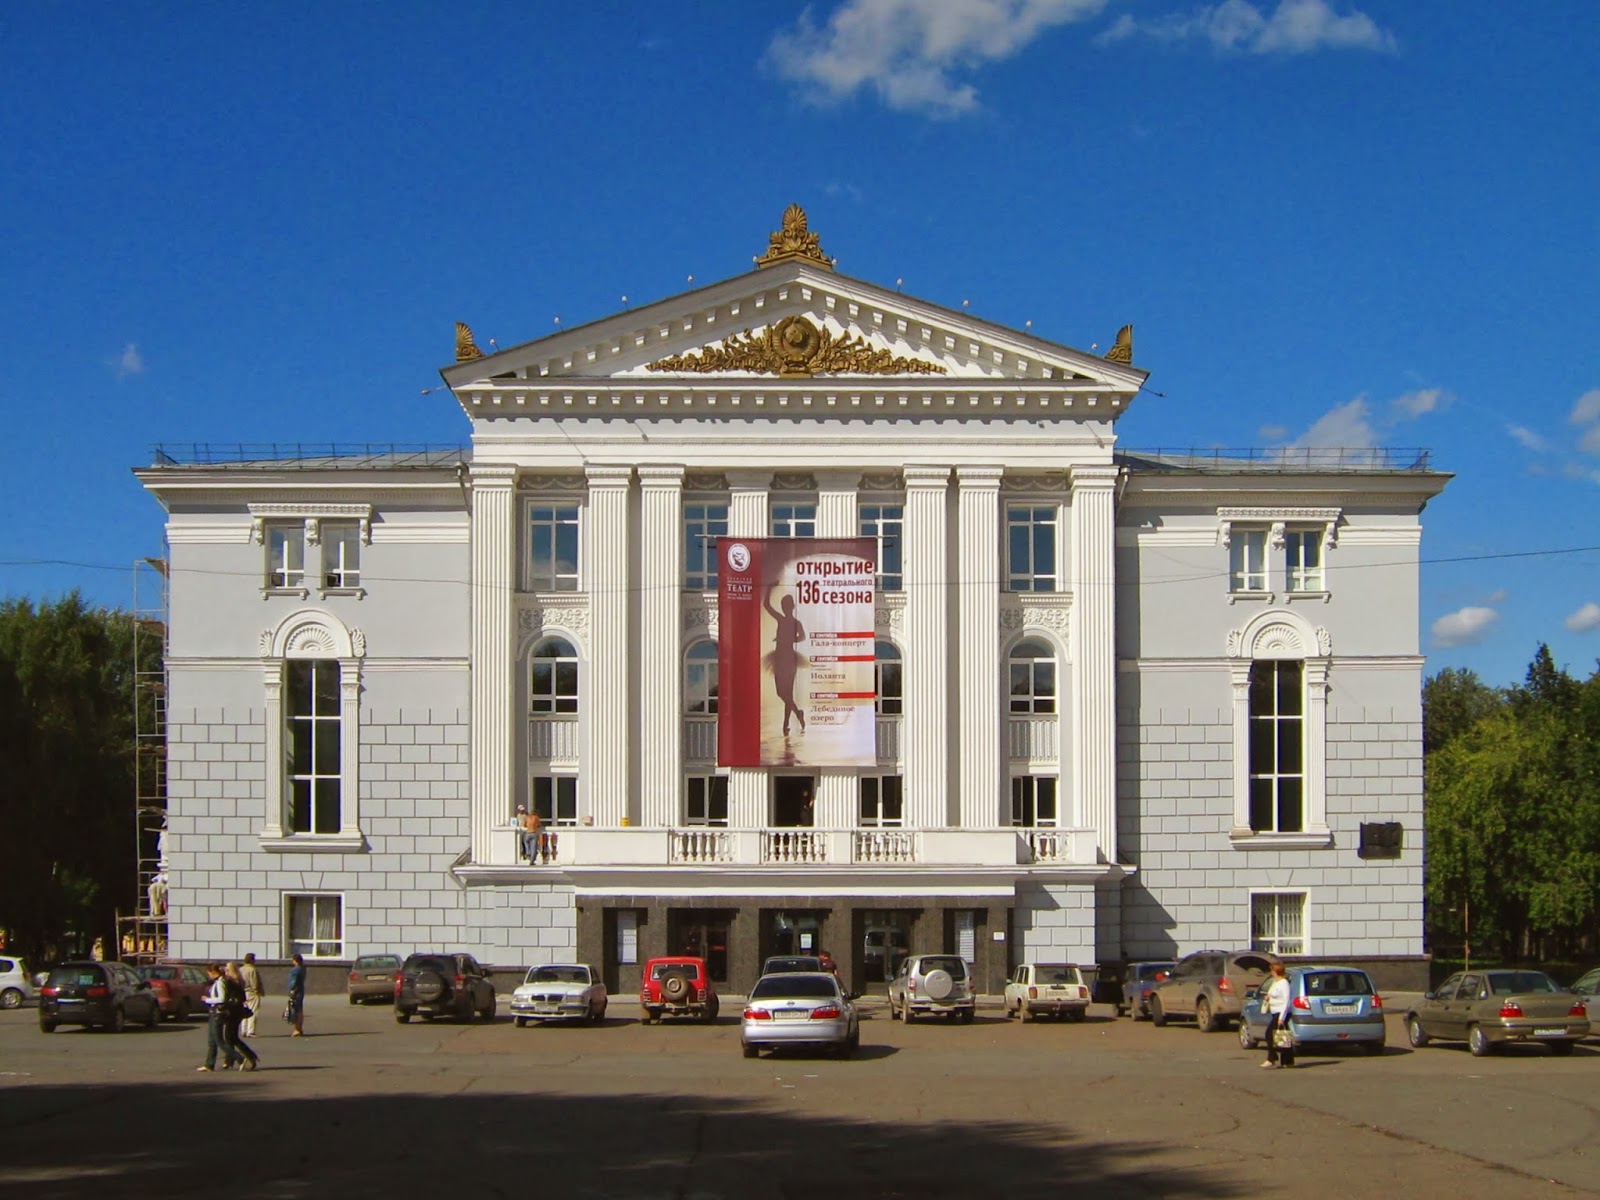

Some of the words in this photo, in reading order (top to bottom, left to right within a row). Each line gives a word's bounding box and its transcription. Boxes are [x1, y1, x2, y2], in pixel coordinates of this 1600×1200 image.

[797, 561, 873, 578] открытие
[726, 584, 752, 592] ТЕАТР
[822, 580, 873, 588] театрального
[797, 580, 820, 604] 136
[822, 591, 873, 604] сезона
[811, 640, 866, 648] Гала-концерт
